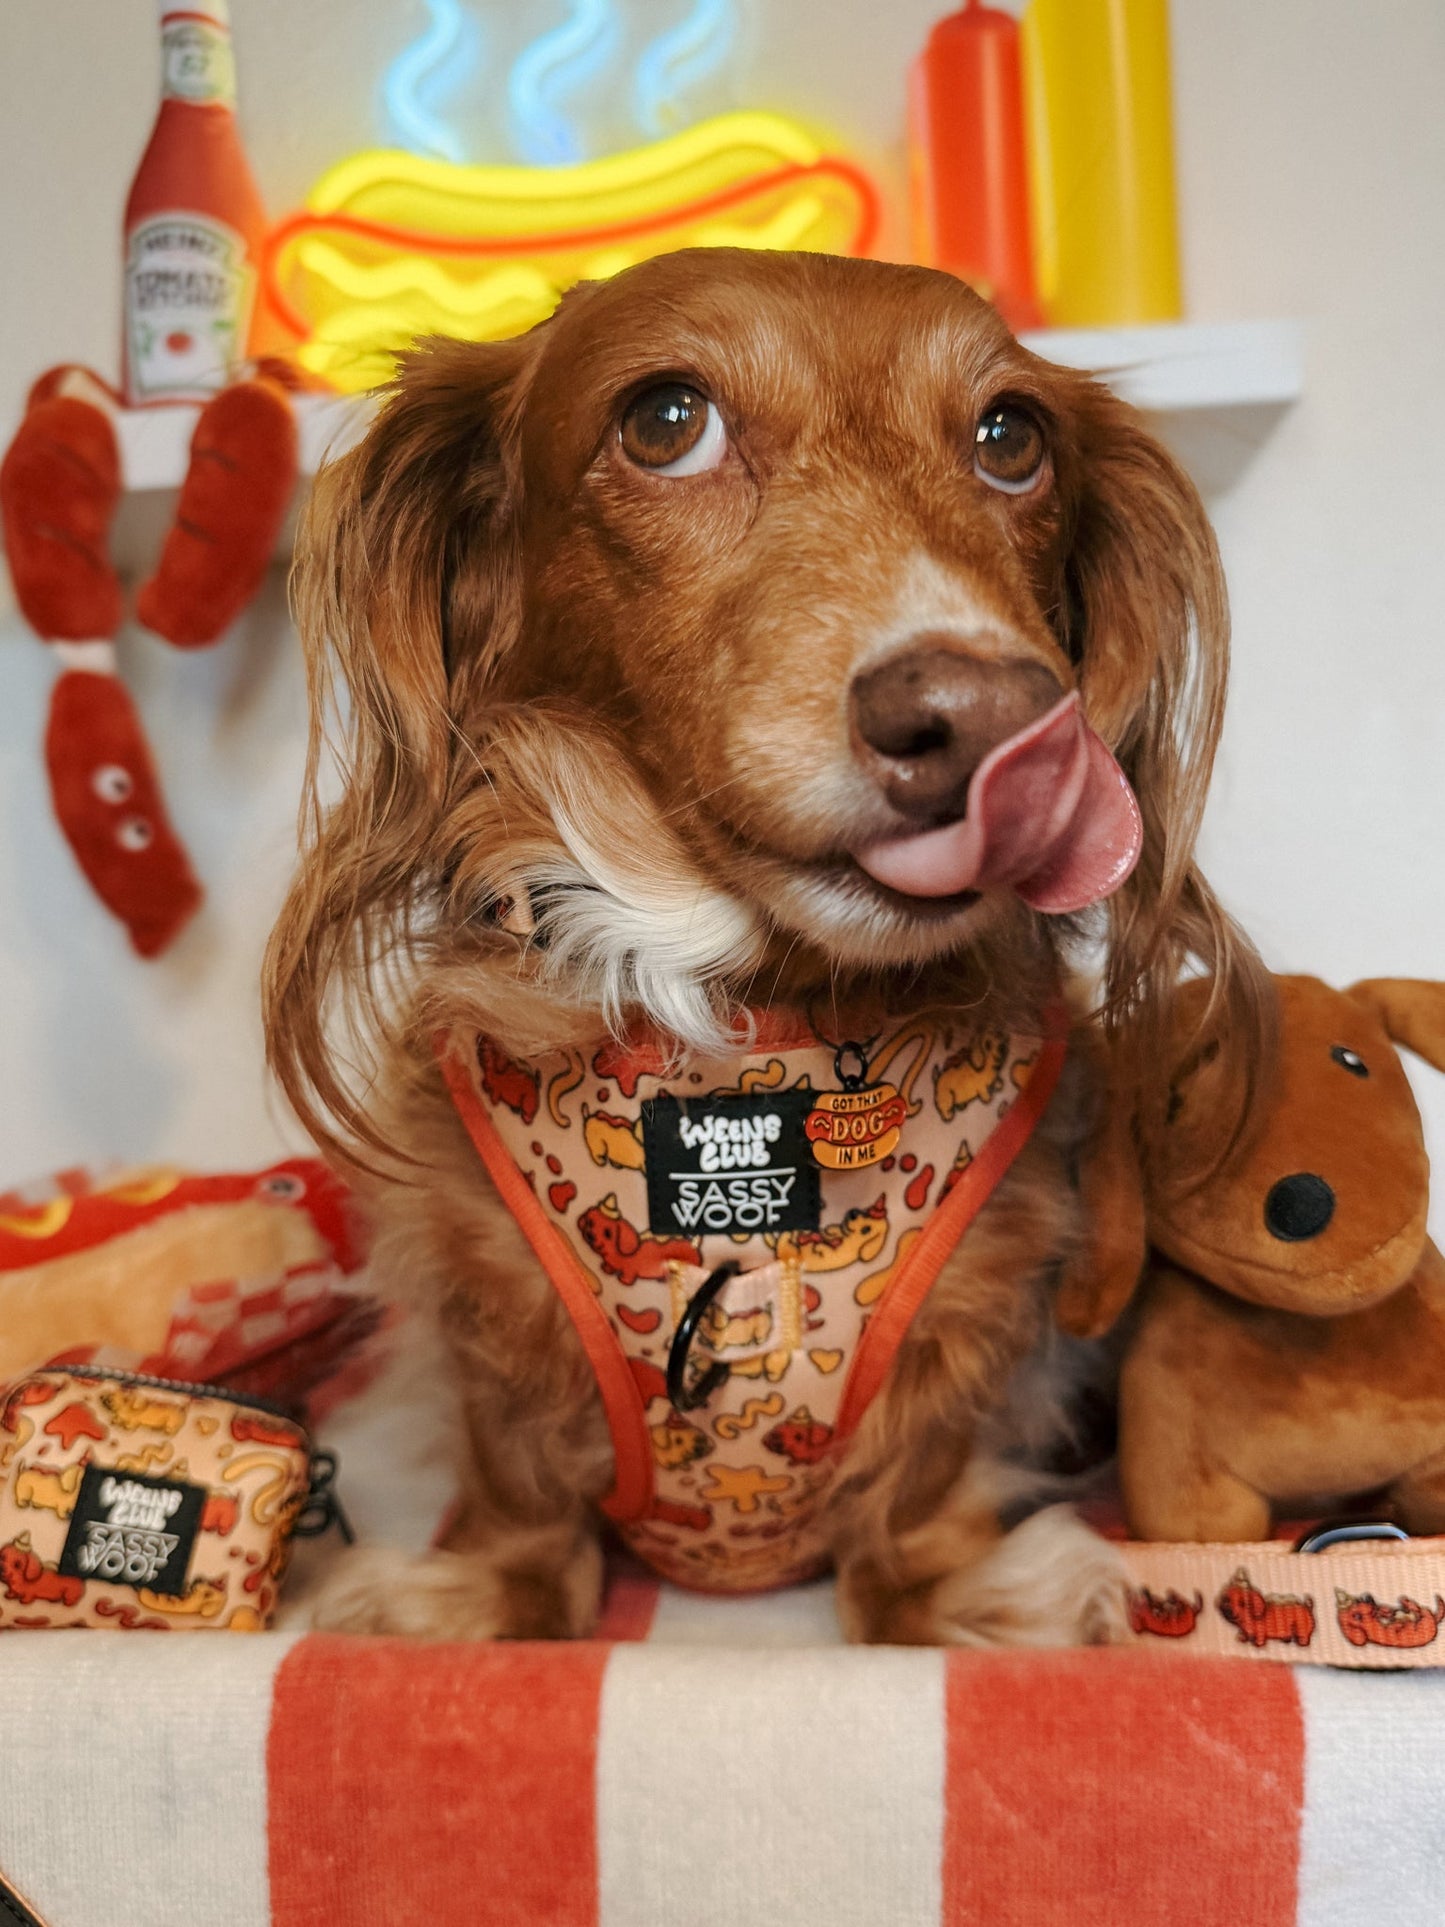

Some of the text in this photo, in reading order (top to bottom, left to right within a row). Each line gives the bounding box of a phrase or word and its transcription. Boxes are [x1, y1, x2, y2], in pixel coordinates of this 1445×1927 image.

[832, 1091, 883, 1110] GOT THAT
[679, 1114, 782, 1149] WEENS
[831, 1115, 883, 1141] DOG
[701, 1140, 771, 1172] CLUB
[837, 1145, 876, 1165] IN ME
[679, 1176, 796, 1206] SASSY
[671, 1201, 790, 1228] WOOF
[87, 1527, 179, 1560] SASSY
[77, 1545, 169, 1582] WOOF
